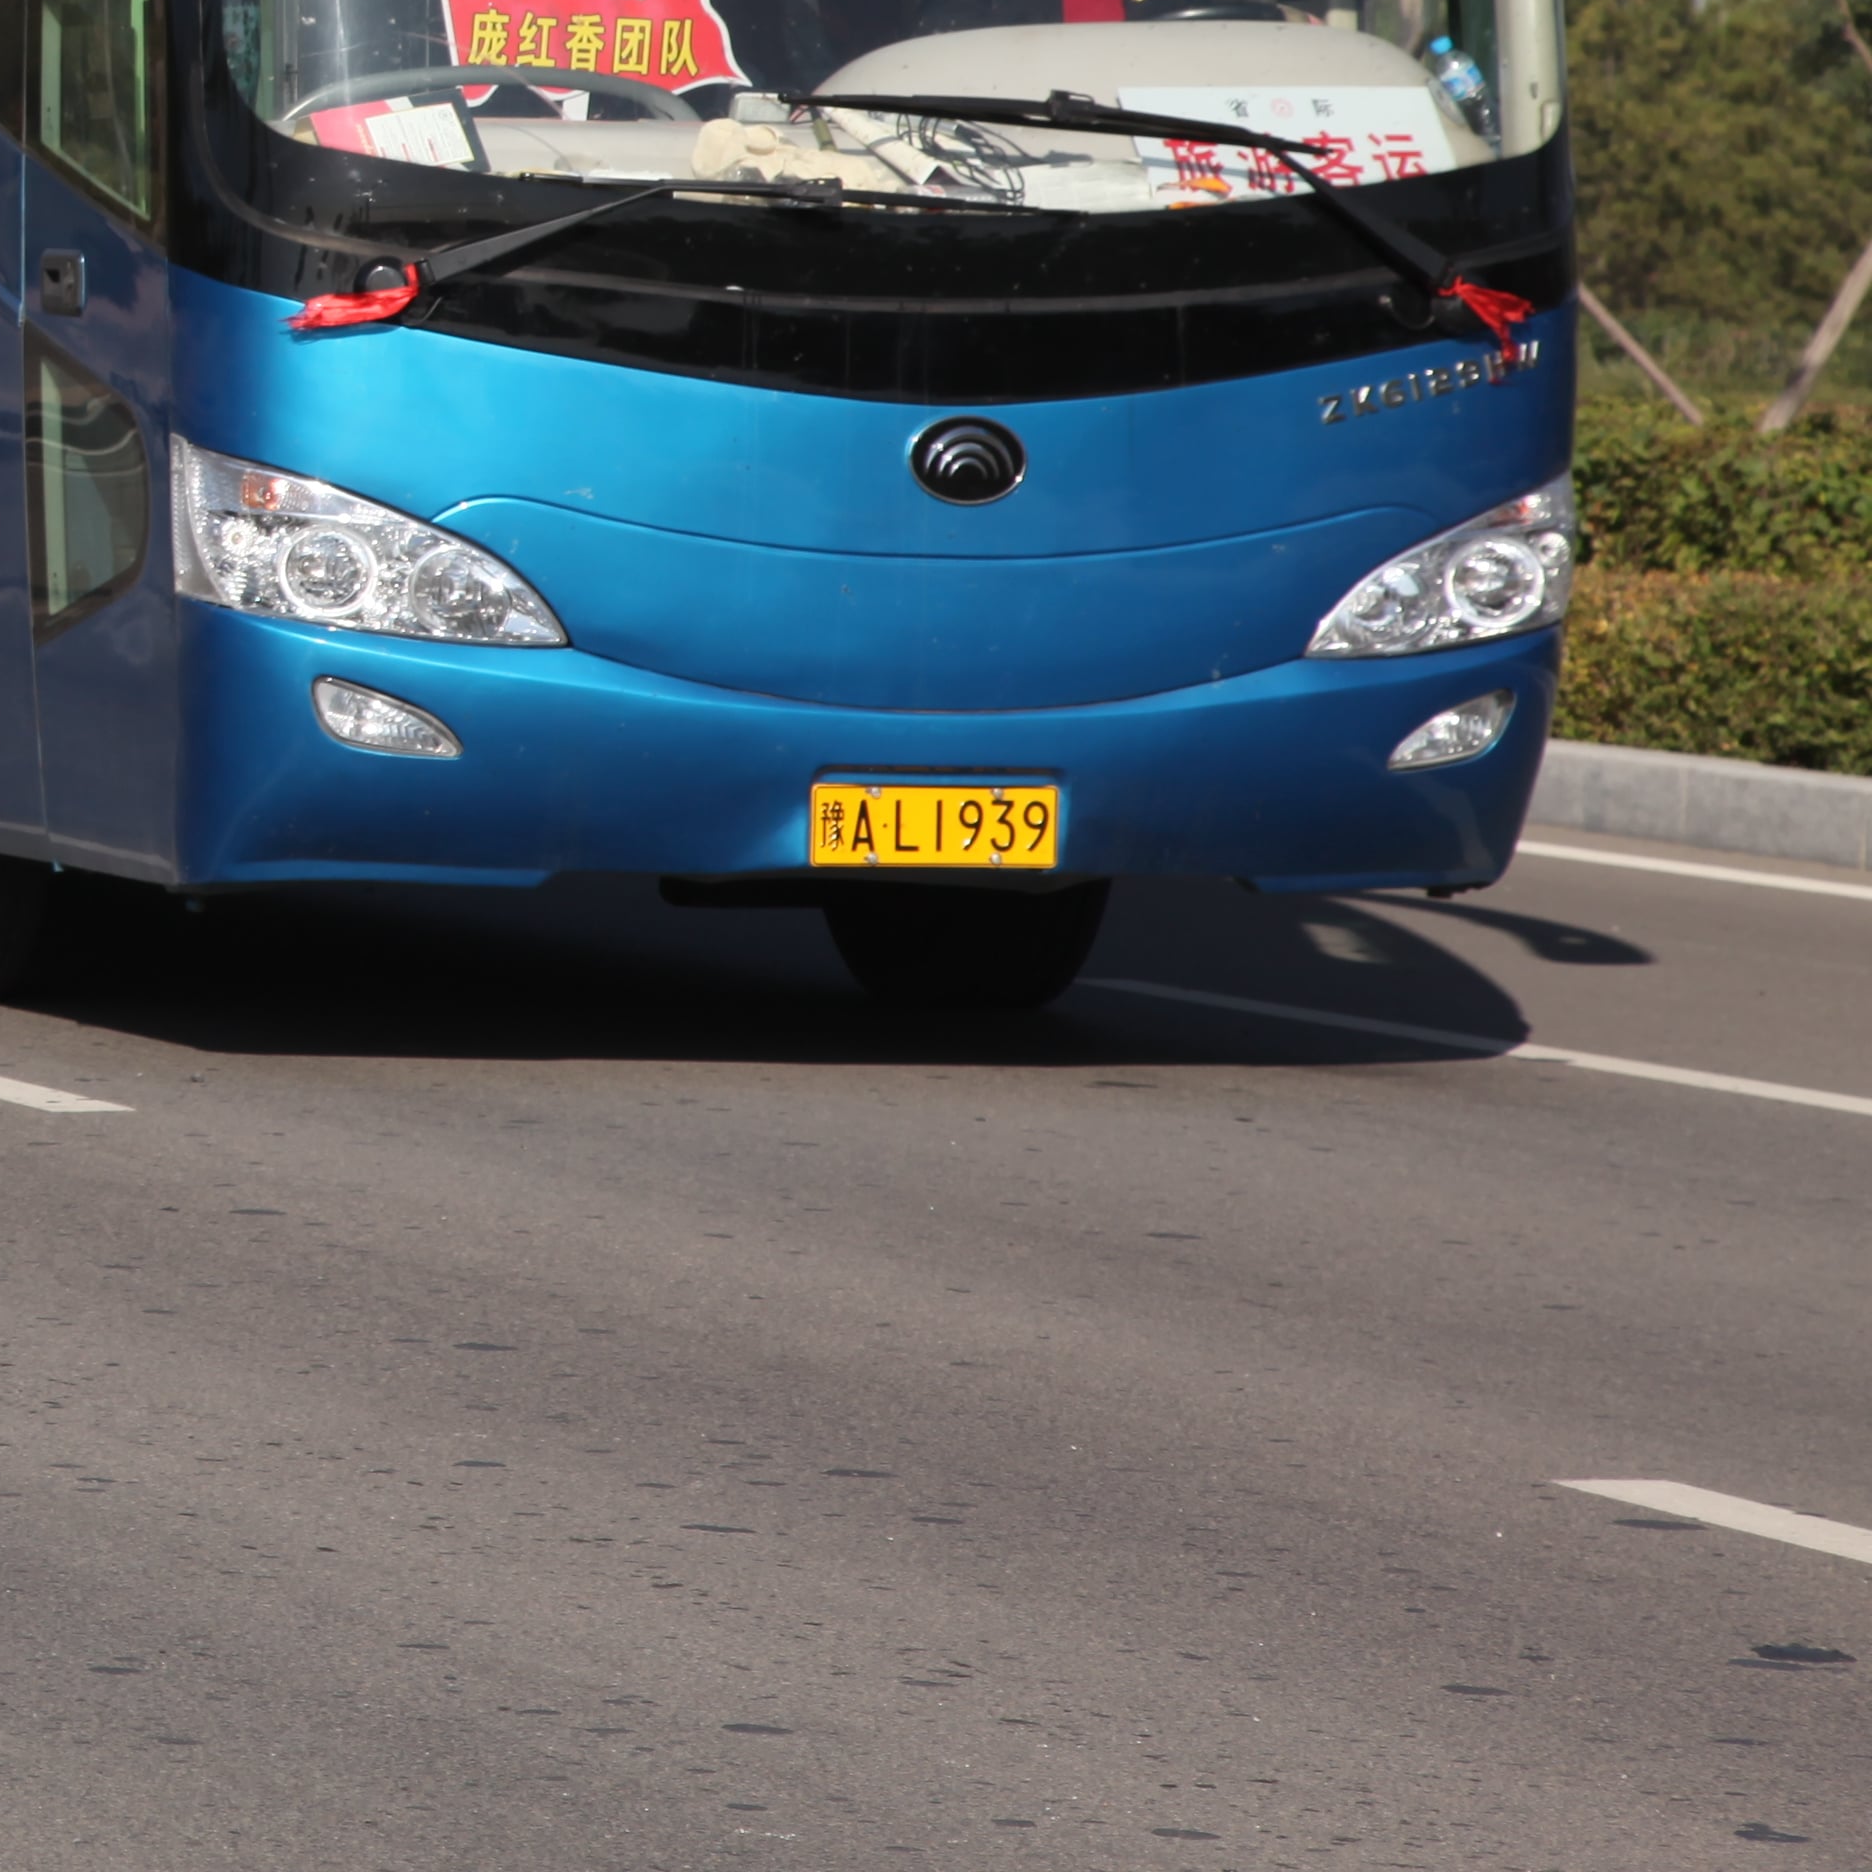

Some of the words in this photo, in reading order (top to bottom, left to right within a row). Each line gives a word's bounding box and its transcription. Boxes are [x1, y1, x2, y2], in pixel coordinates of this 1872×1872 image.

[467, 8, 700, 77] 庞红香团队
